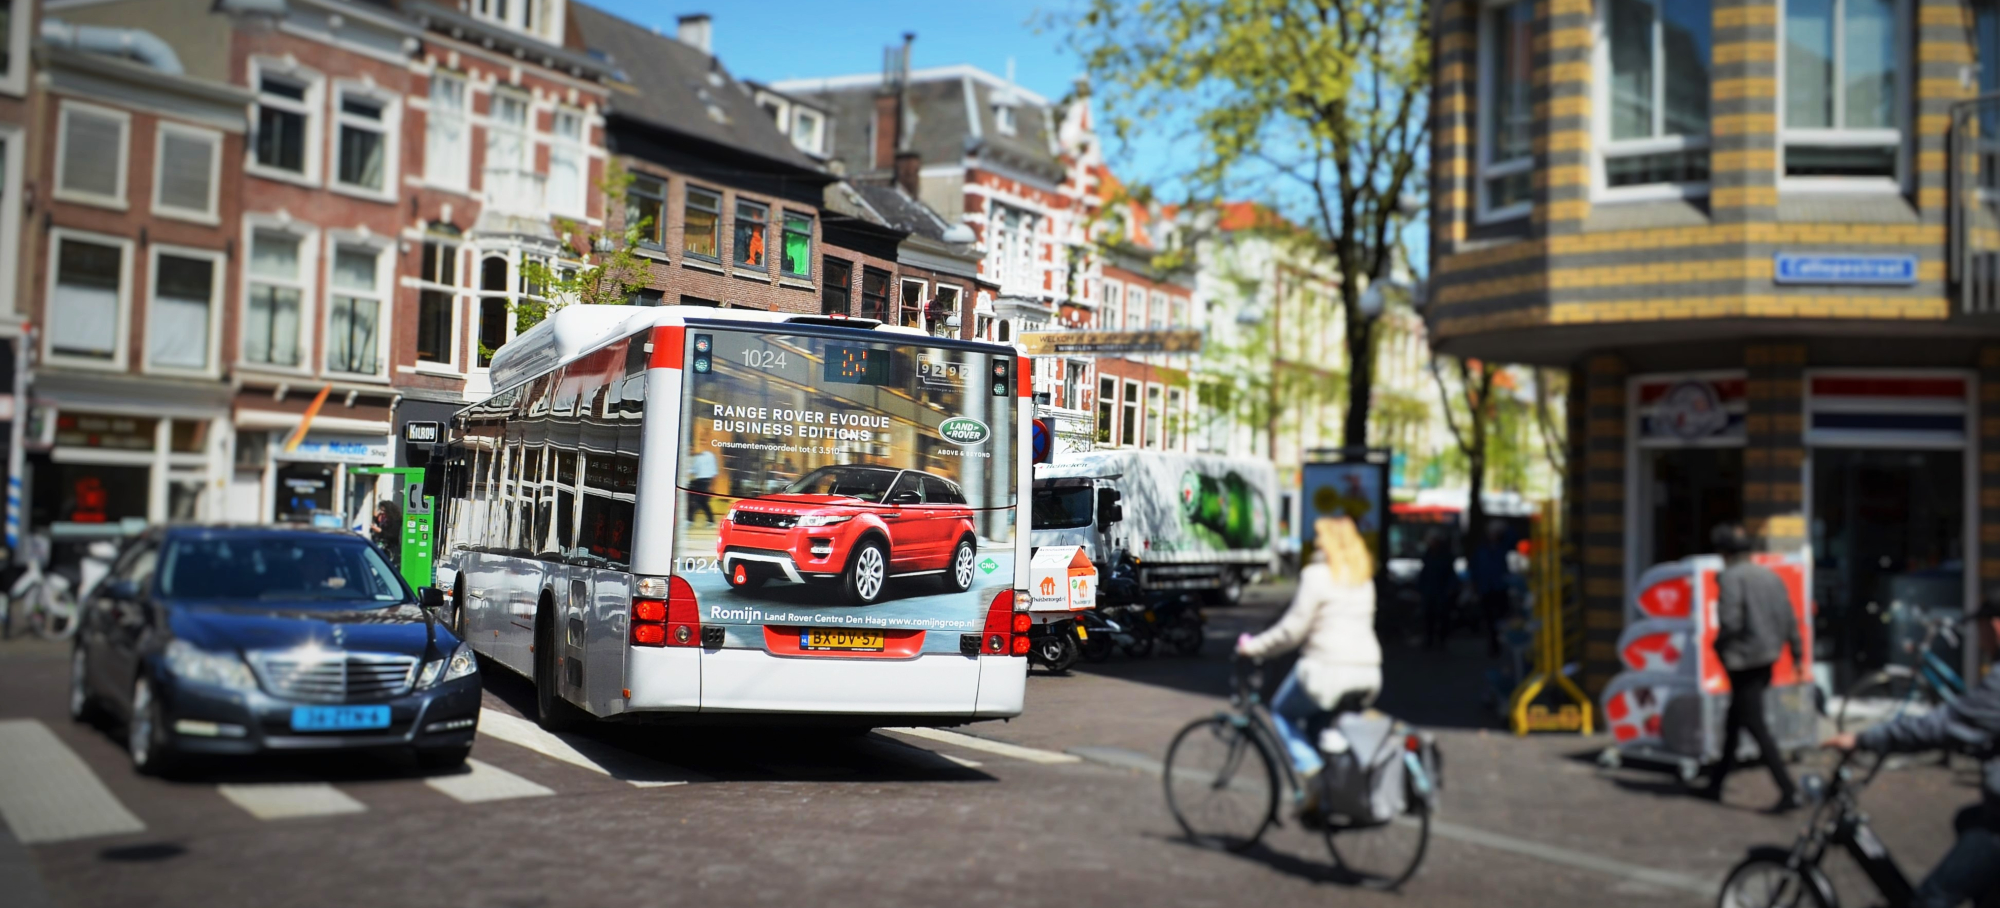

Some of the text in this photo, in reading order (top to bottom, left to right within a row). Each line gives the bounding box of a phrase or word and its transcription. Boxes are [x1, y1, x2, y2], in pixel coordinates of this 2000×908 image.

[1040, 335, 1074, 343] WELKOM
[742, 349, 787, 369] 1024
[921, 363, 970, 378] 9292
[713, 404, 890, 428] RANGE ROVER EVOQUE
[713, 419, 870, 442] BUSINESS EDITIONS
[949, 422, 973, 431] LAND
[952, 430, 981, 440] ROVER
[328, 440, 368, 456] Mobile
[371, 449, 387, 457] Shop
[711, 439, 797, 453] Consumentenvoordeel
[818, 446, 840, 455] 3.510
[673, 557, 719, 574] 1024
[710, 605, 975, 628] Romijn Land Rover Centre Den Haag www.romijngroep.nl
[813, 631, 879, 646] BX-DV-57
